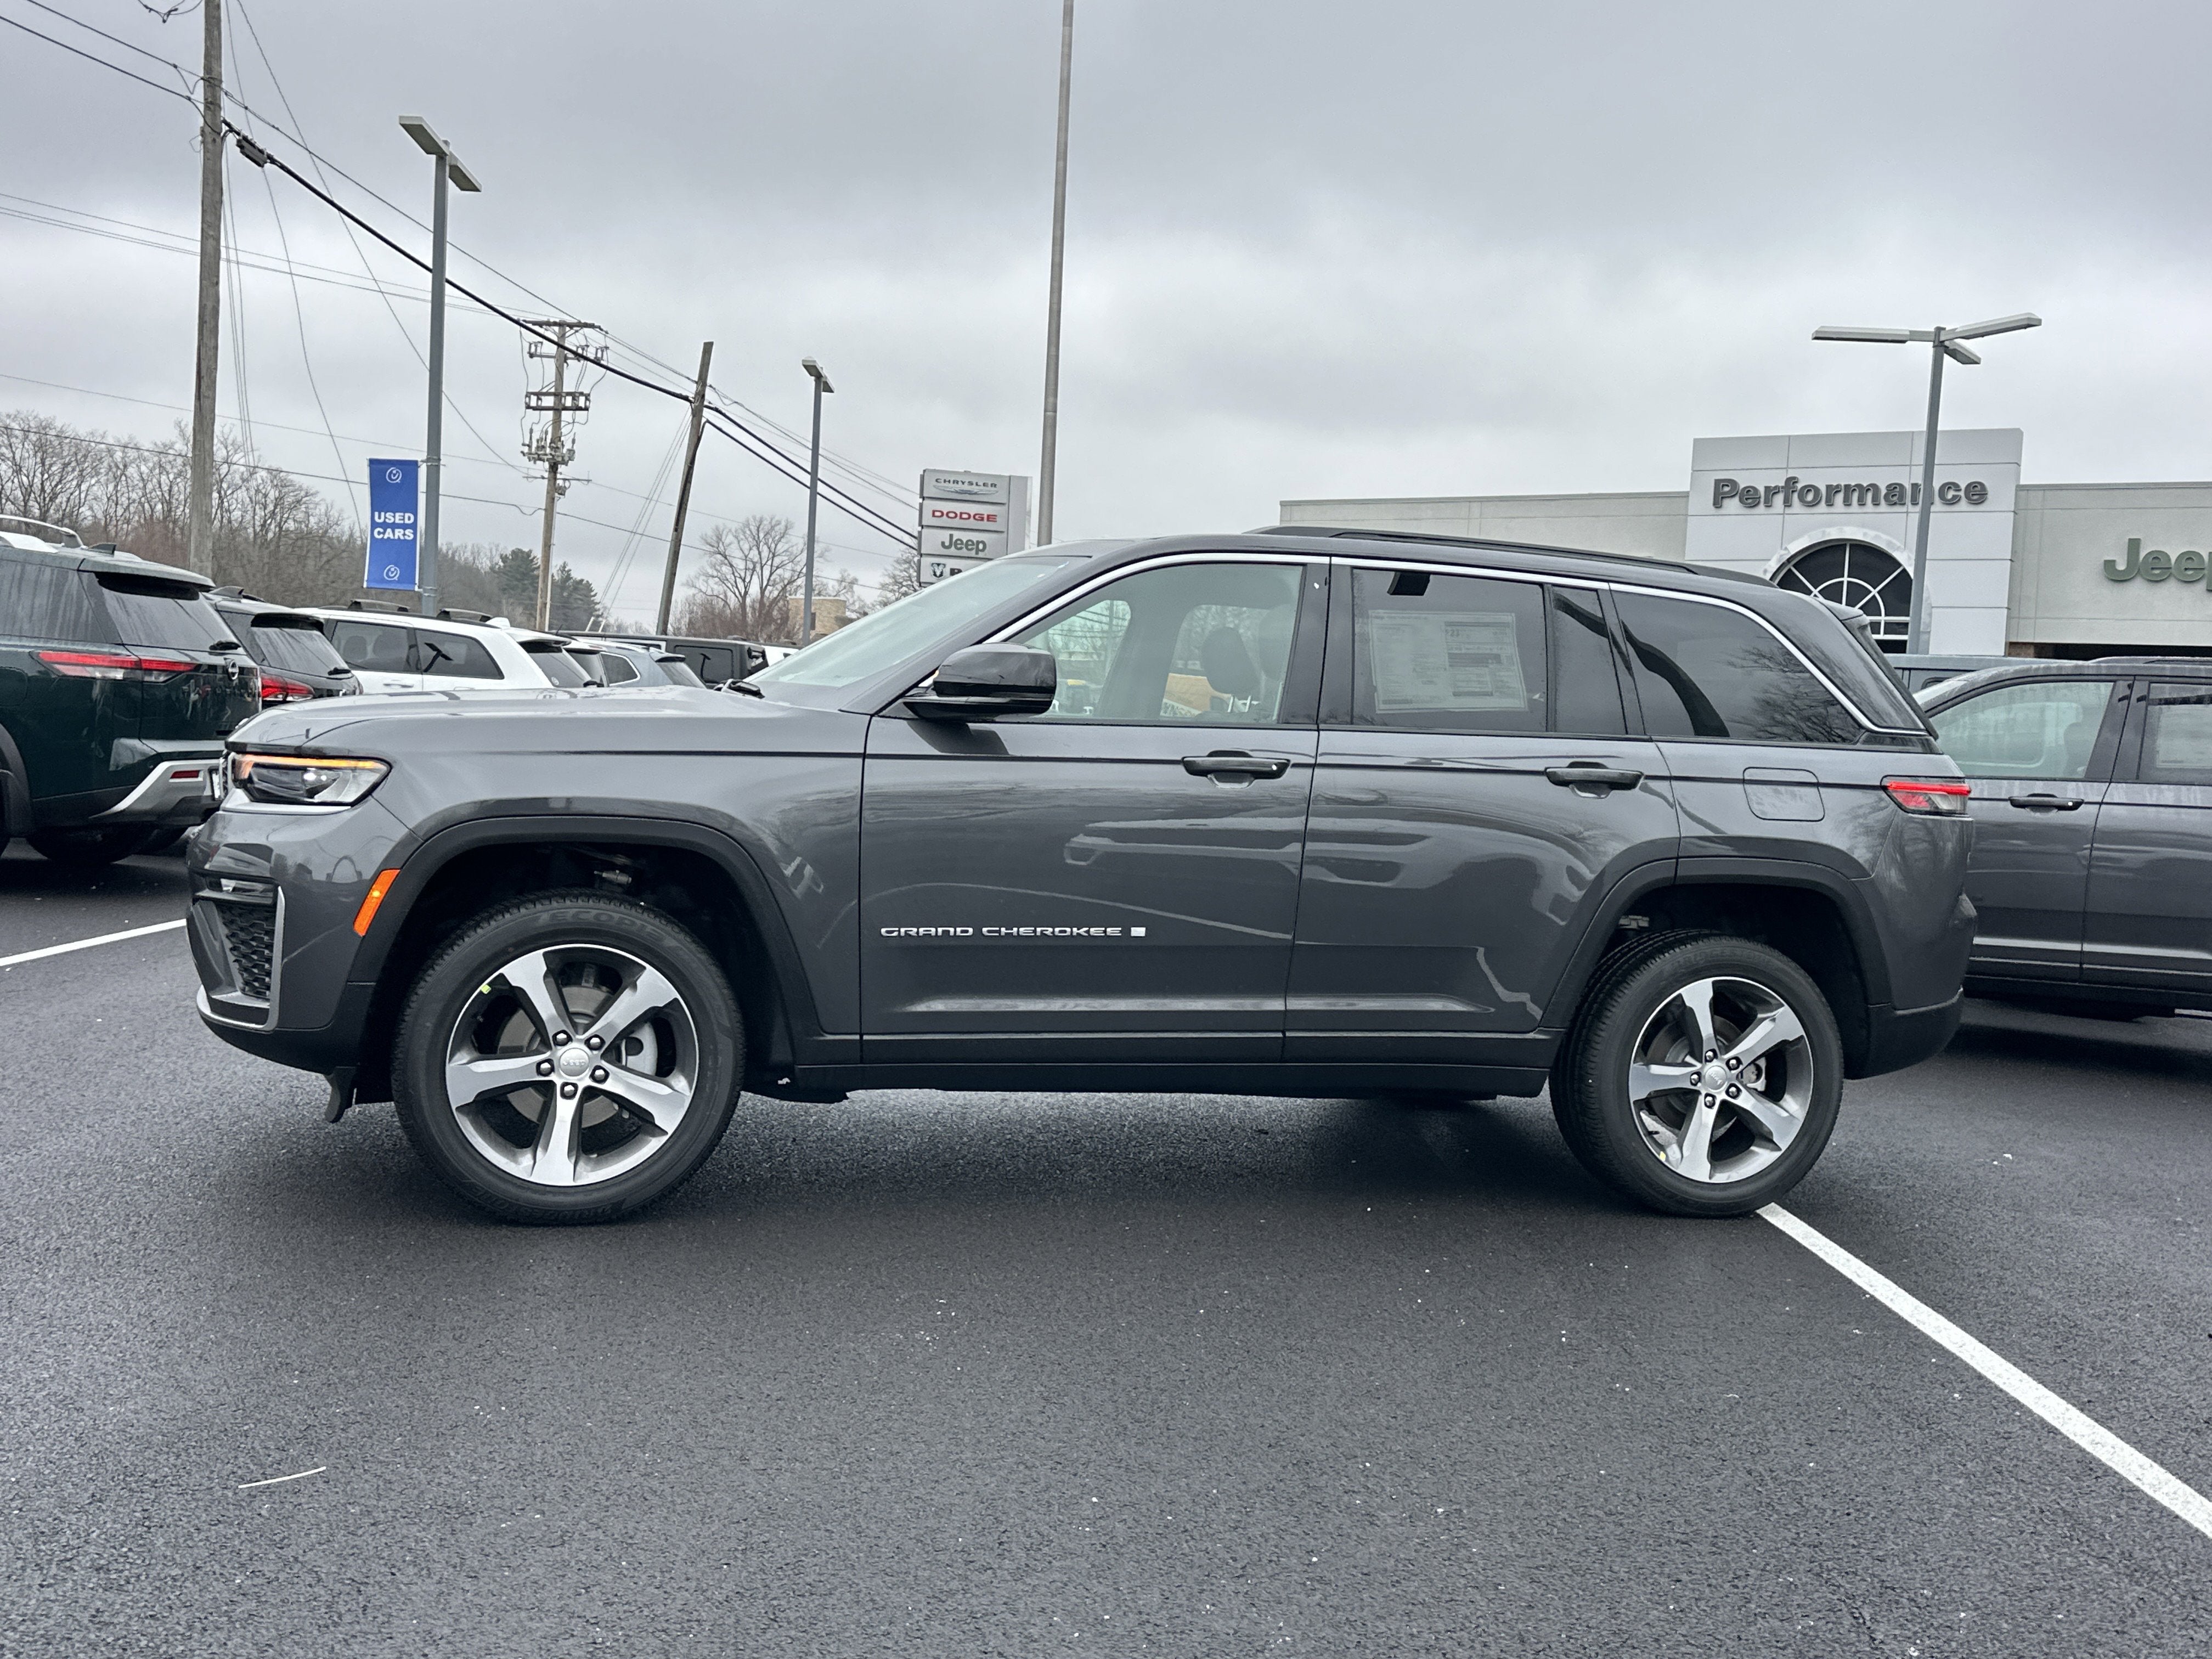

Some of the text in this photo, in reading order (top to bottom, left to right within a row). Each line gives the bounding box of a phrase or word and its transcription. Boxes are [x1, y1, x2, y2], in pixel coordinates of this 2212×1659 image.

[935, 477, 998, 488] CHRYSLER
[1712, 476, 1989, 508] Performance
[374, 511, 415, 524] USED
[932, 509, 998, 523] DODGE
[374, 528, 414, 540] CARS
[940, 533, 987, 555] Jeep
[2103, 537, 2212, 591] Jee
[880, 927, 1123, 938] GRAND CHEROKEE
